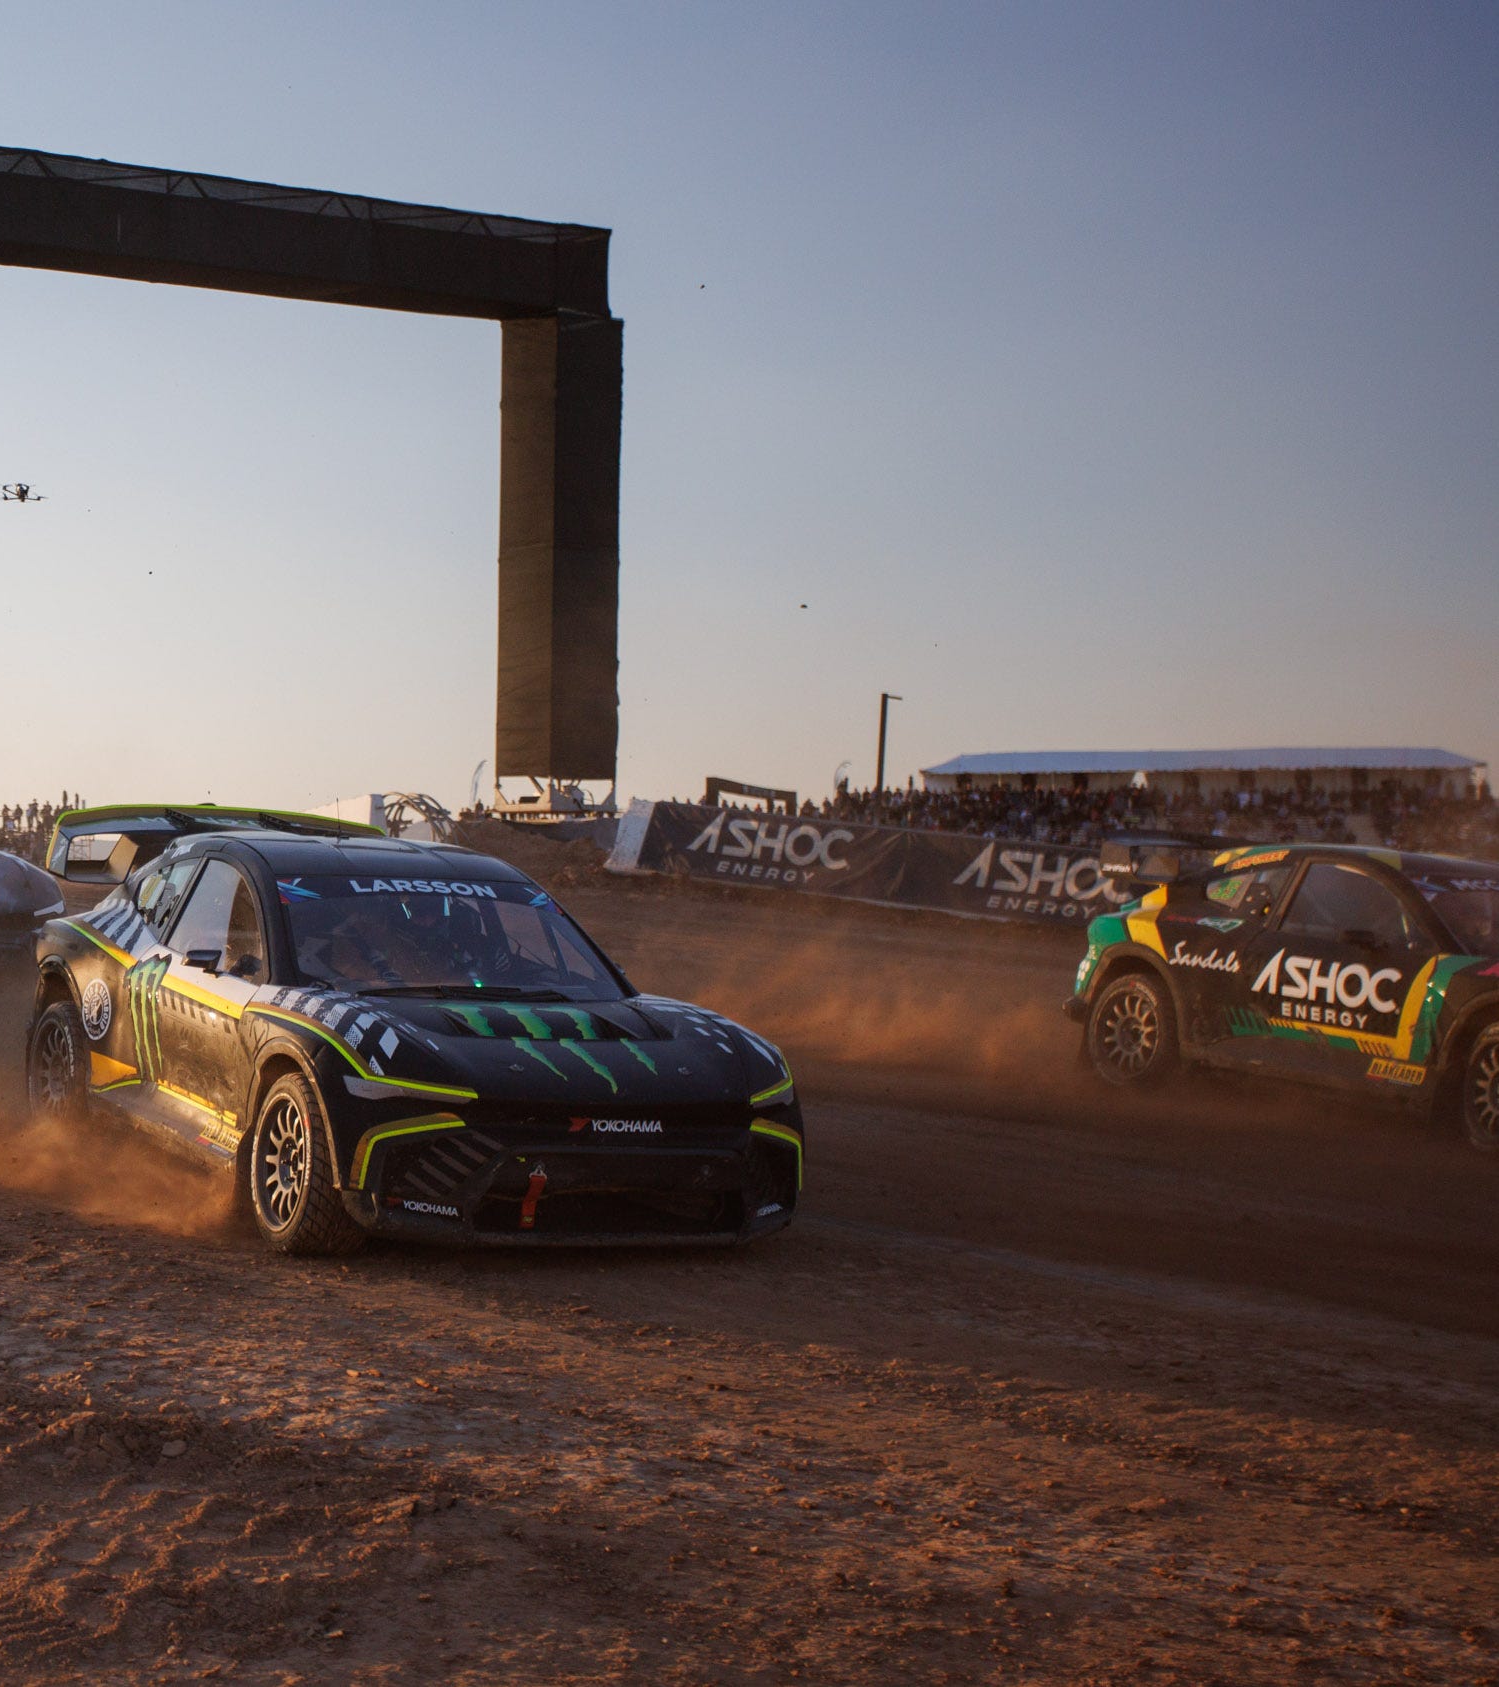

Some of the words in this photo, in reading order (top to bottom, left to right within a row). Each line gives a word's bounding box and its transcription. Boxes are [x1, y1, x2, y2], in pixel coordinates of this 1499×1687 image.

[687, 812, 854, 870] ASHOC
[716, 861, 815, 883] ENERGY
[349, 879, 497, 898] LARSSON
[986, 895, 1097, 920] ENERGY
[1169, 940, 1240, 974] Sandals
[1251, 947, 1402, 1014] ASHOC
[1281, 1002, 1368, 1029] ENERGY
[591, 1119, 662, 1133] YOKOHAMA
[403, 1200, 459, 1217] YOKOHAMA
